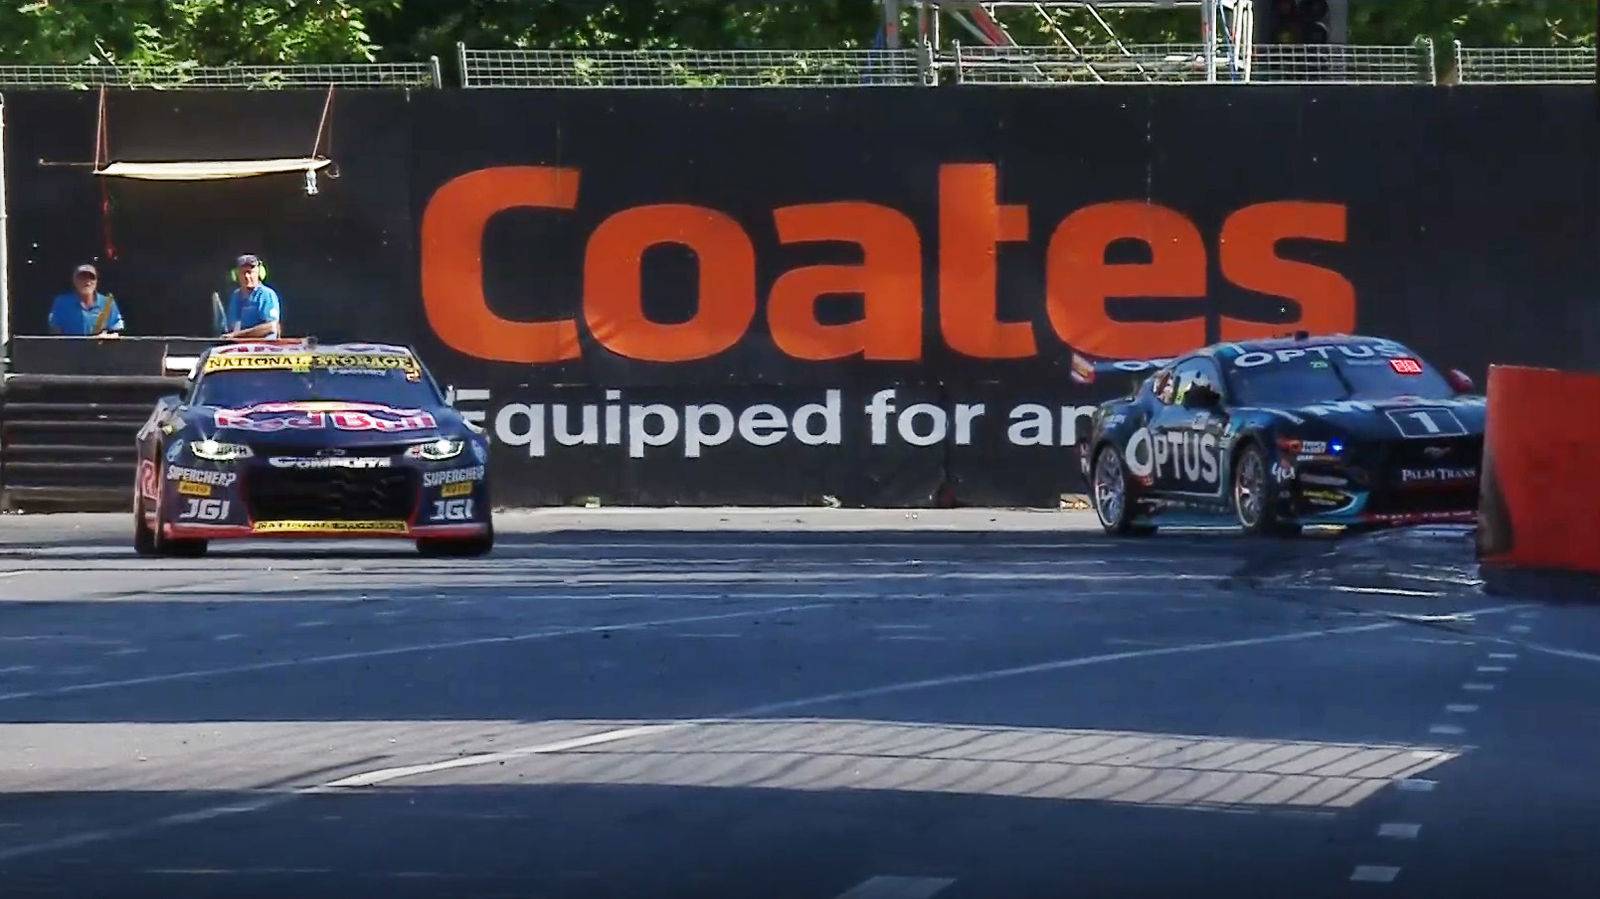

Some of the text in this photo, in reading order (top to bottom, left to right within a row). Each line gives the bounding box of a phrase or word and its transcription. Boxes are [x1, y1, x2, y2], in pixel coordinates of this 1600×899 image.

[421, 162, 1357, 363] Coates
[208, 355, 310, 368] NATIONAL
[1234, 342, 1408, 368] OPTUS
[214, 411, 438, 432] Red Bull
[870, 388, 985, 446] for
[1408, 411, 1440, 433] 1
[1125, 427, 1218, 484] OPTUS
[166, 464, 237, 487] SUPERCHEAP
[1401, 469, 1436, 482] PALM
[178, 498, 231, 521] JGI
[430, 498, 475, 521] JGI
